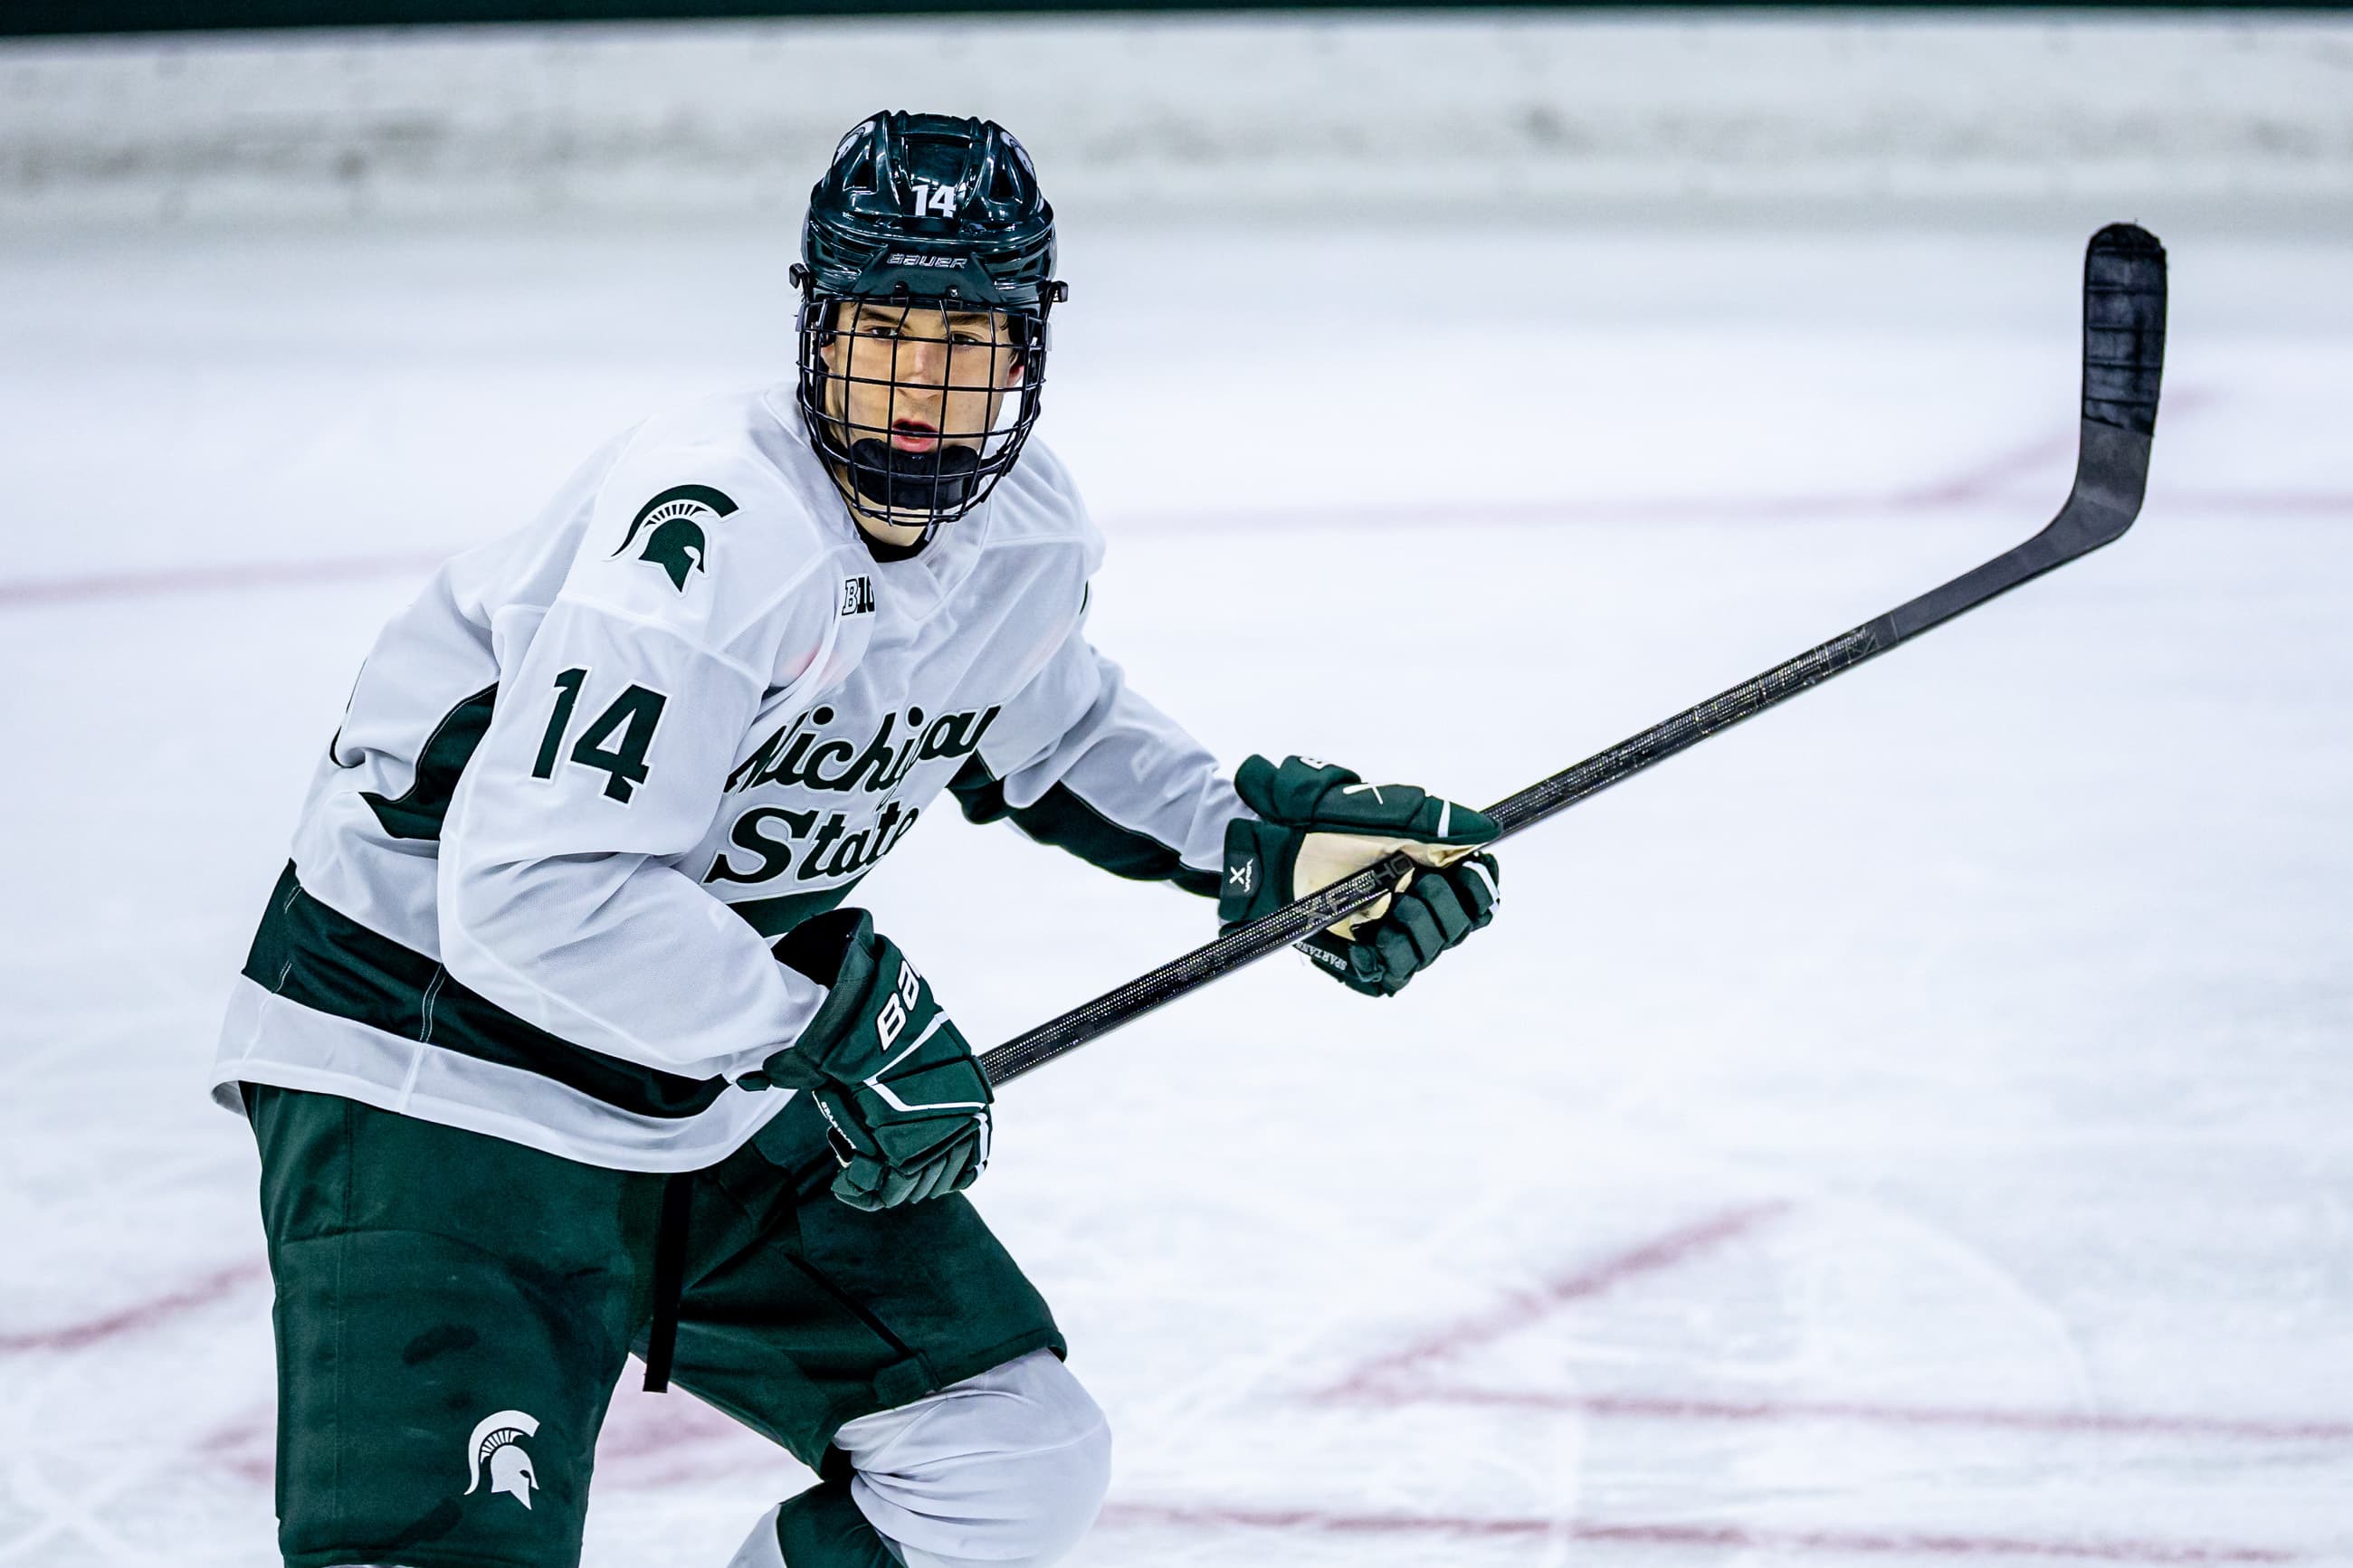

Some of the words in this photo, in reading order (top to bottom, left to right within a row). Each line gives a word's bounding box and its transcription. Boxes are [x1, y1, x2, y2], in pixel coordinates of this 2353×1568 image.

[912, 185, 956, 217] 14
[887, 253, 967, 269] BAUER
[531, 668, 668, 804] 14
[703, 801, 919, 884] State
[877, 959, 920, 1050] BA
